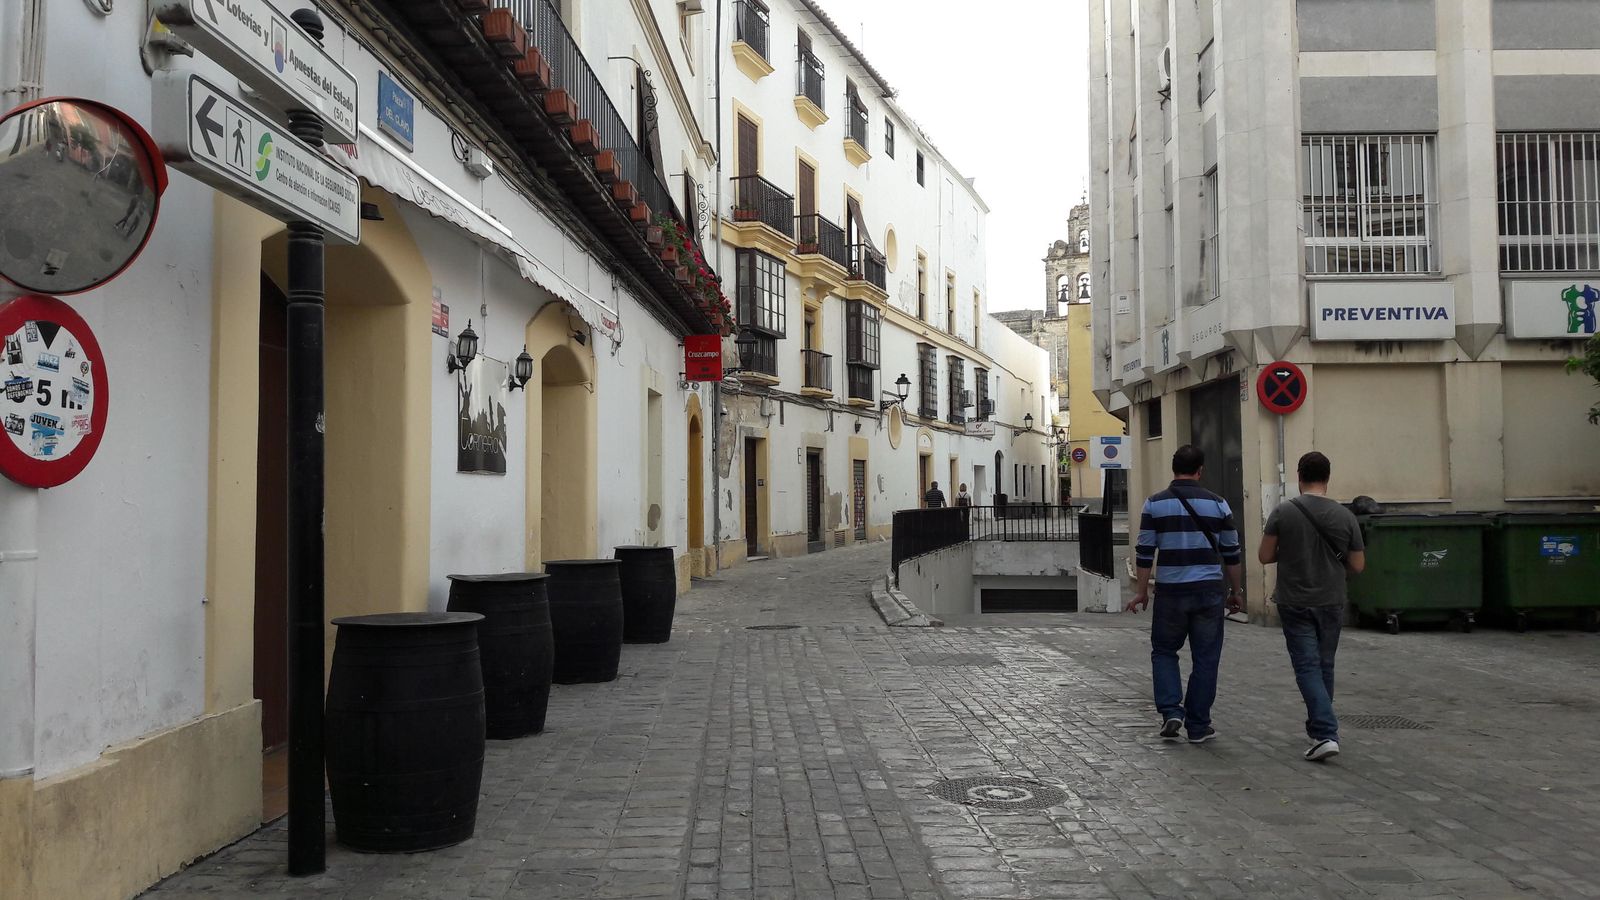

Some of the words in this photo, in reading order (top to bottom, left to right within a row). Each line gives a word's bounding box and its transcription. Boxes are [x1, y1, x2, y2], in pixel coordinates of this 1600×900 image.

[264, 29, 269, 47] y
[289, 49, 321, 86] Apuestas
[322, 77, 332, 95] del
[333, 85, 354, 113] Estado
[334, 106, 344, 122] (50
[276, 168, 288, 186] Centro
[325, 176, 345, 198] SEGURIDAD
[1322, 306, 1449, 321] PREVENTIVA
[688, 350, 719, 358] Cruzcampo
